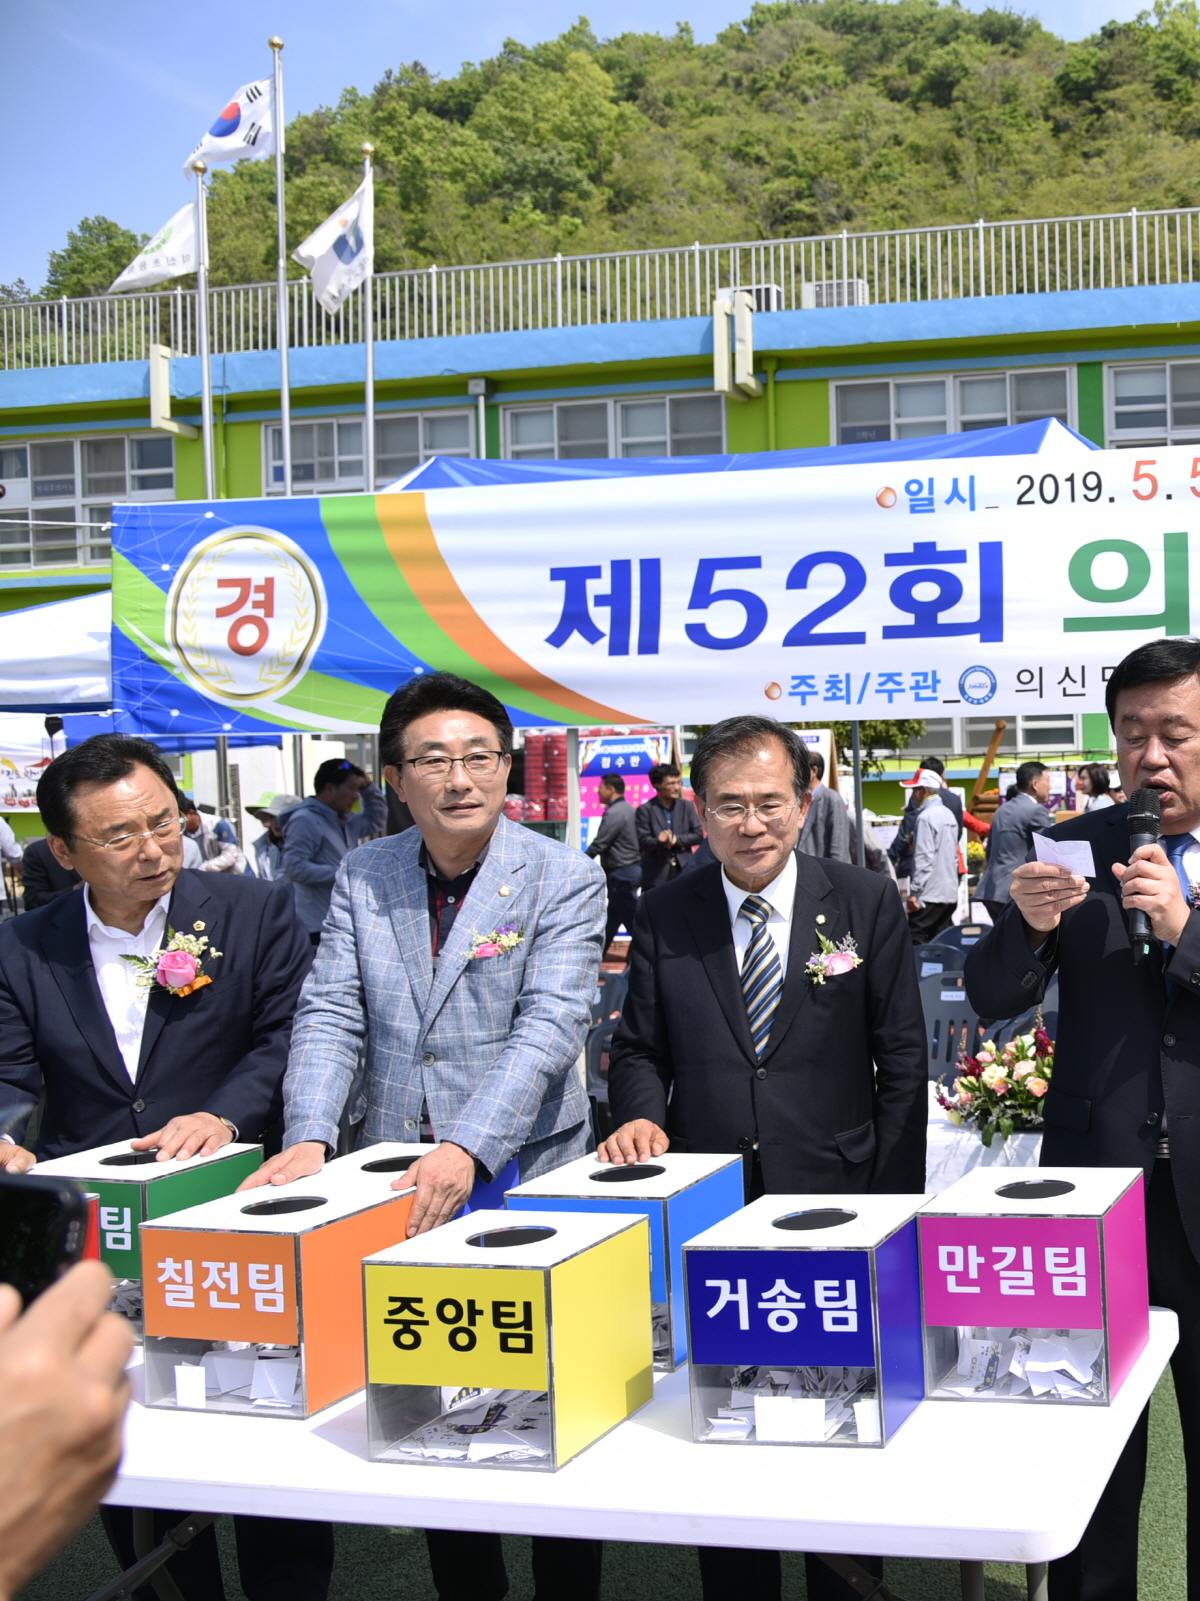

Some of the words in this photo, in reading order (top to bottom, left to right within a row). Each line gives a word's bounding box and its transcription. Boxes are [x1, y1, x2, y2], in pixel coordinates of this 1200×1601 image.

[1016, 470, 1116, 506] 2019.
[1132, 459, 1174, 501] 5.
[215, 576, 275, 657] 경
[545, 541, 1004, 657] 제52회
[100, 1206, 131, 1251] 팀
[156, 1257, 286, 1314] 칠전팀
[938, 1245, 1087, 1298] 만길팀
[383, 1295, 533, 1355] 중앙팀
[704, 1278, 858, 1333] 거송팀
